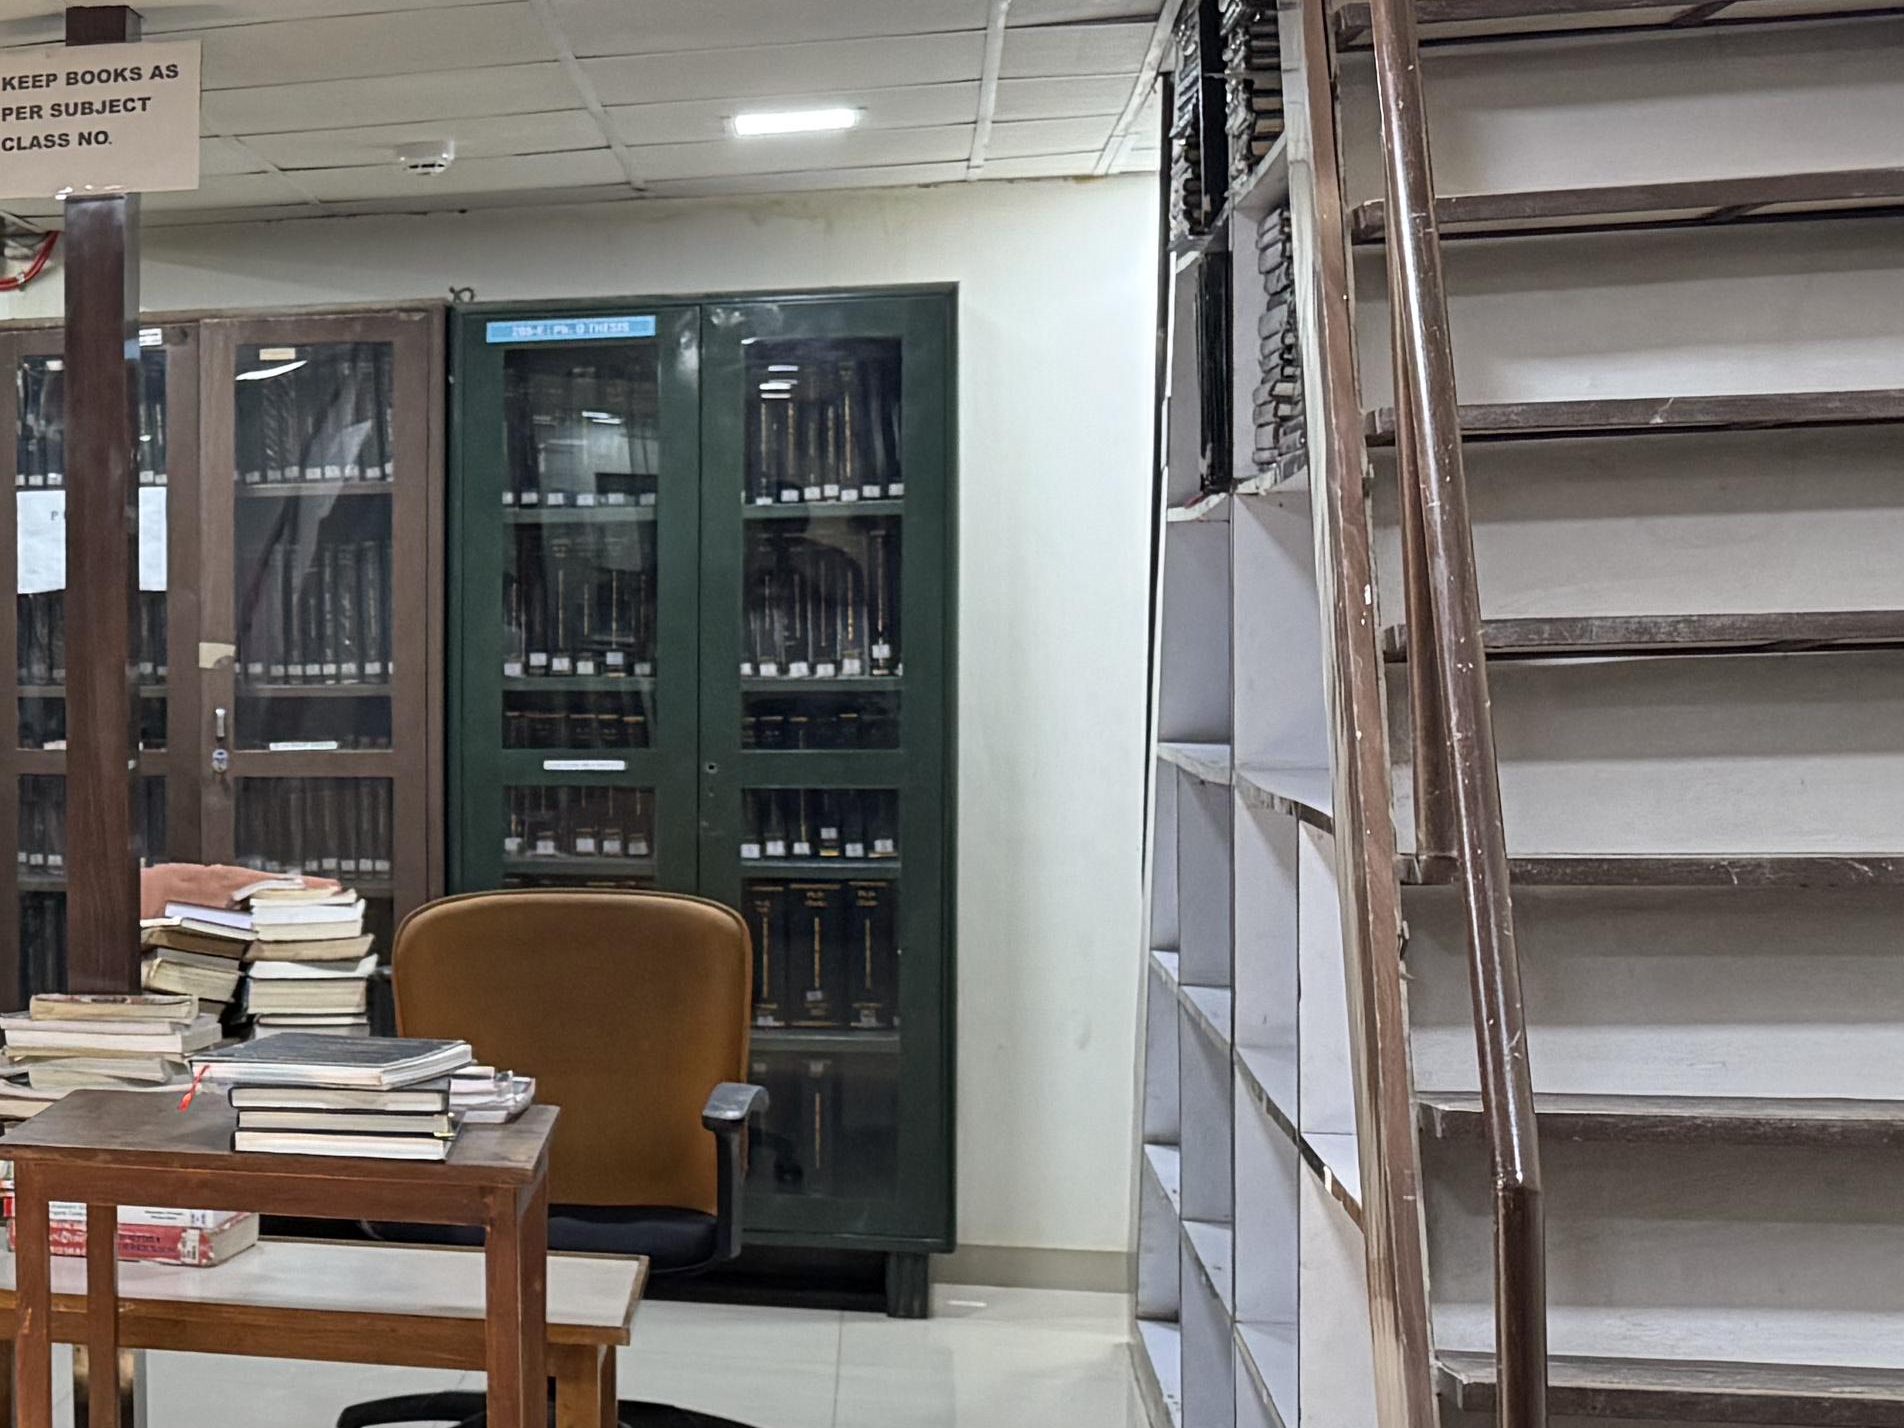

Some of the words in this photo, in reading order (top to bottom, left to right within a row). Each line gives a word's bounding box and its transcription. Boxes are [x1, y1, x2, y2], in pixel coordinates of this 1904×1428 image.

[1, 73, 58, 92] KEEP
[65, 66, 143, 87] BOOKS
[148, 63, 180, 80] AS
[1, 104, 43, 122] PER
[50, 96, 152, 118] SUBJECT
[1, 132, 70, 152] CLASS
[77, 130, 113, 147] NO.
